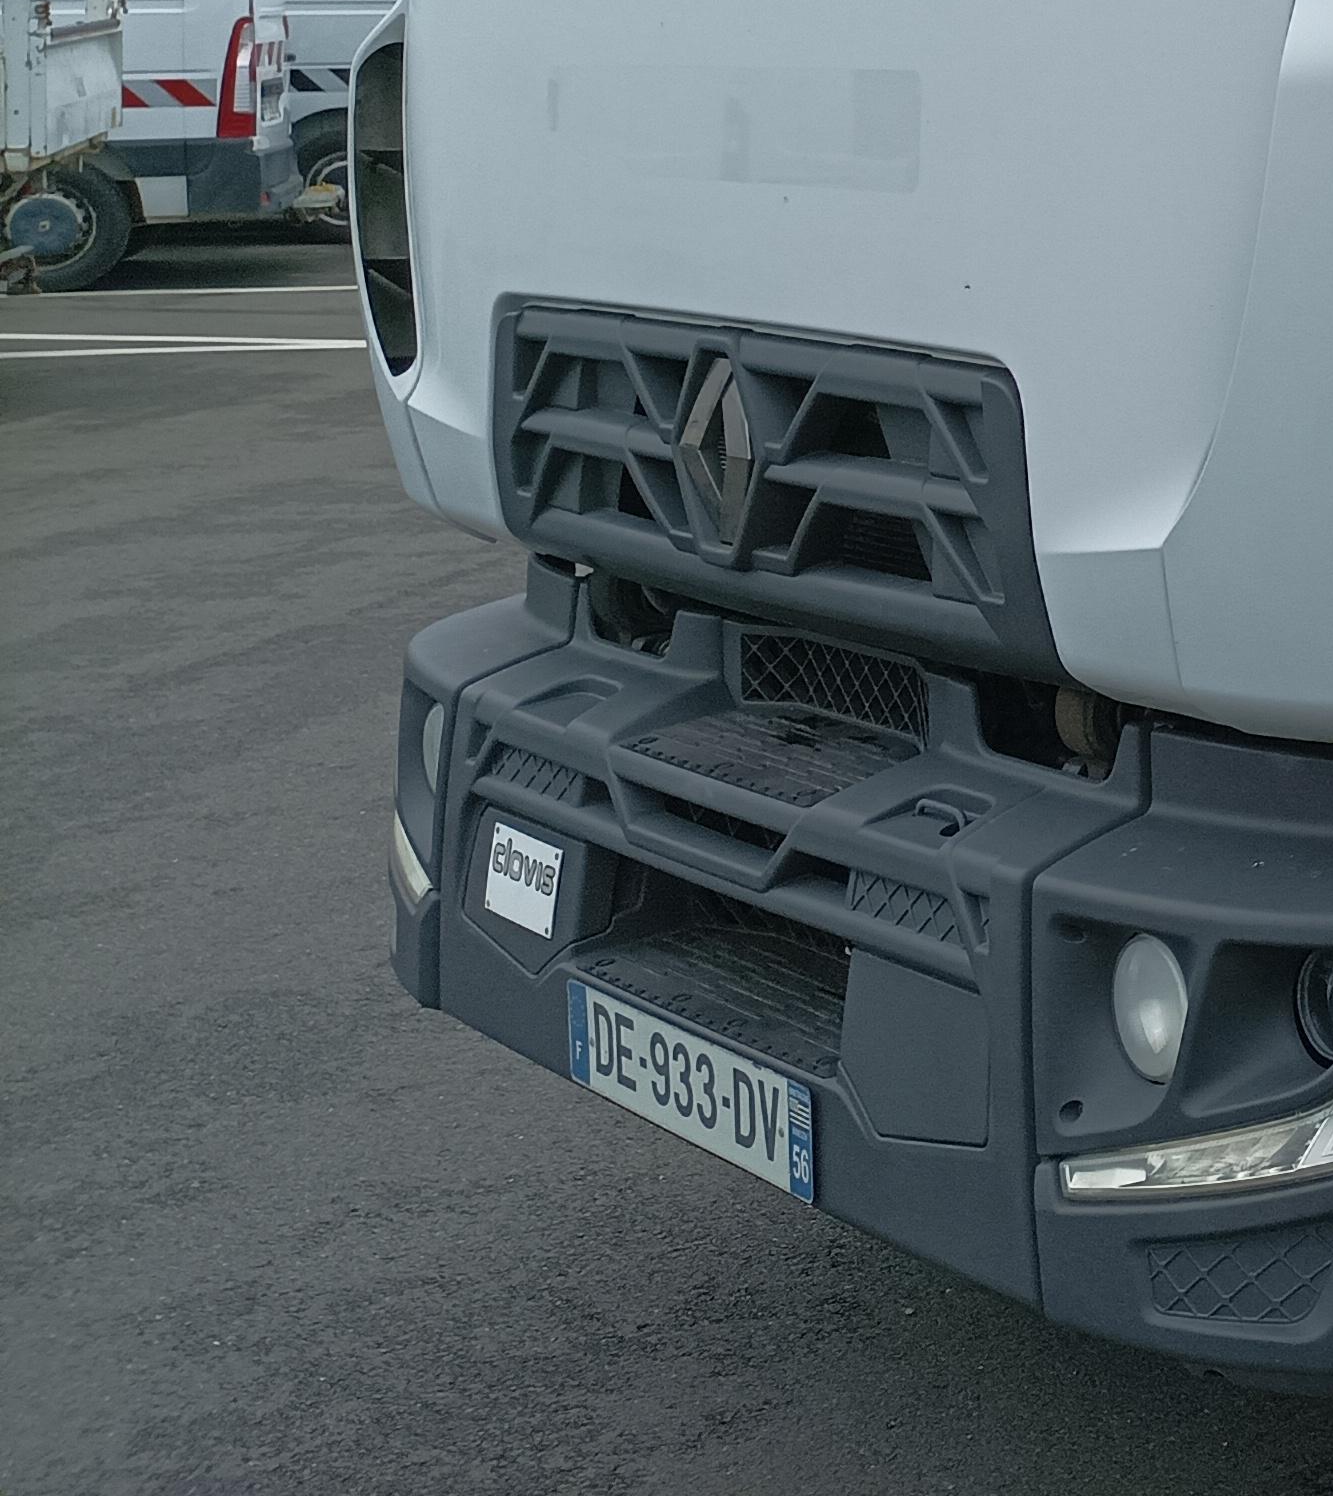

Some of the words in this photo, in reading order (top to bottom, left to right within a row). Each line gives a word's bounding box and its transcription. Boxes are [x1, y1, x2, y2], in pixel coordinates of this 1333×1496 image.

[492, 837, 556, 896] clovis
[575, 1040, 583, 1060] F
[593, 1000, 780, 1163] DE-933-DV
[792, 1144, 809, 1184] 56
